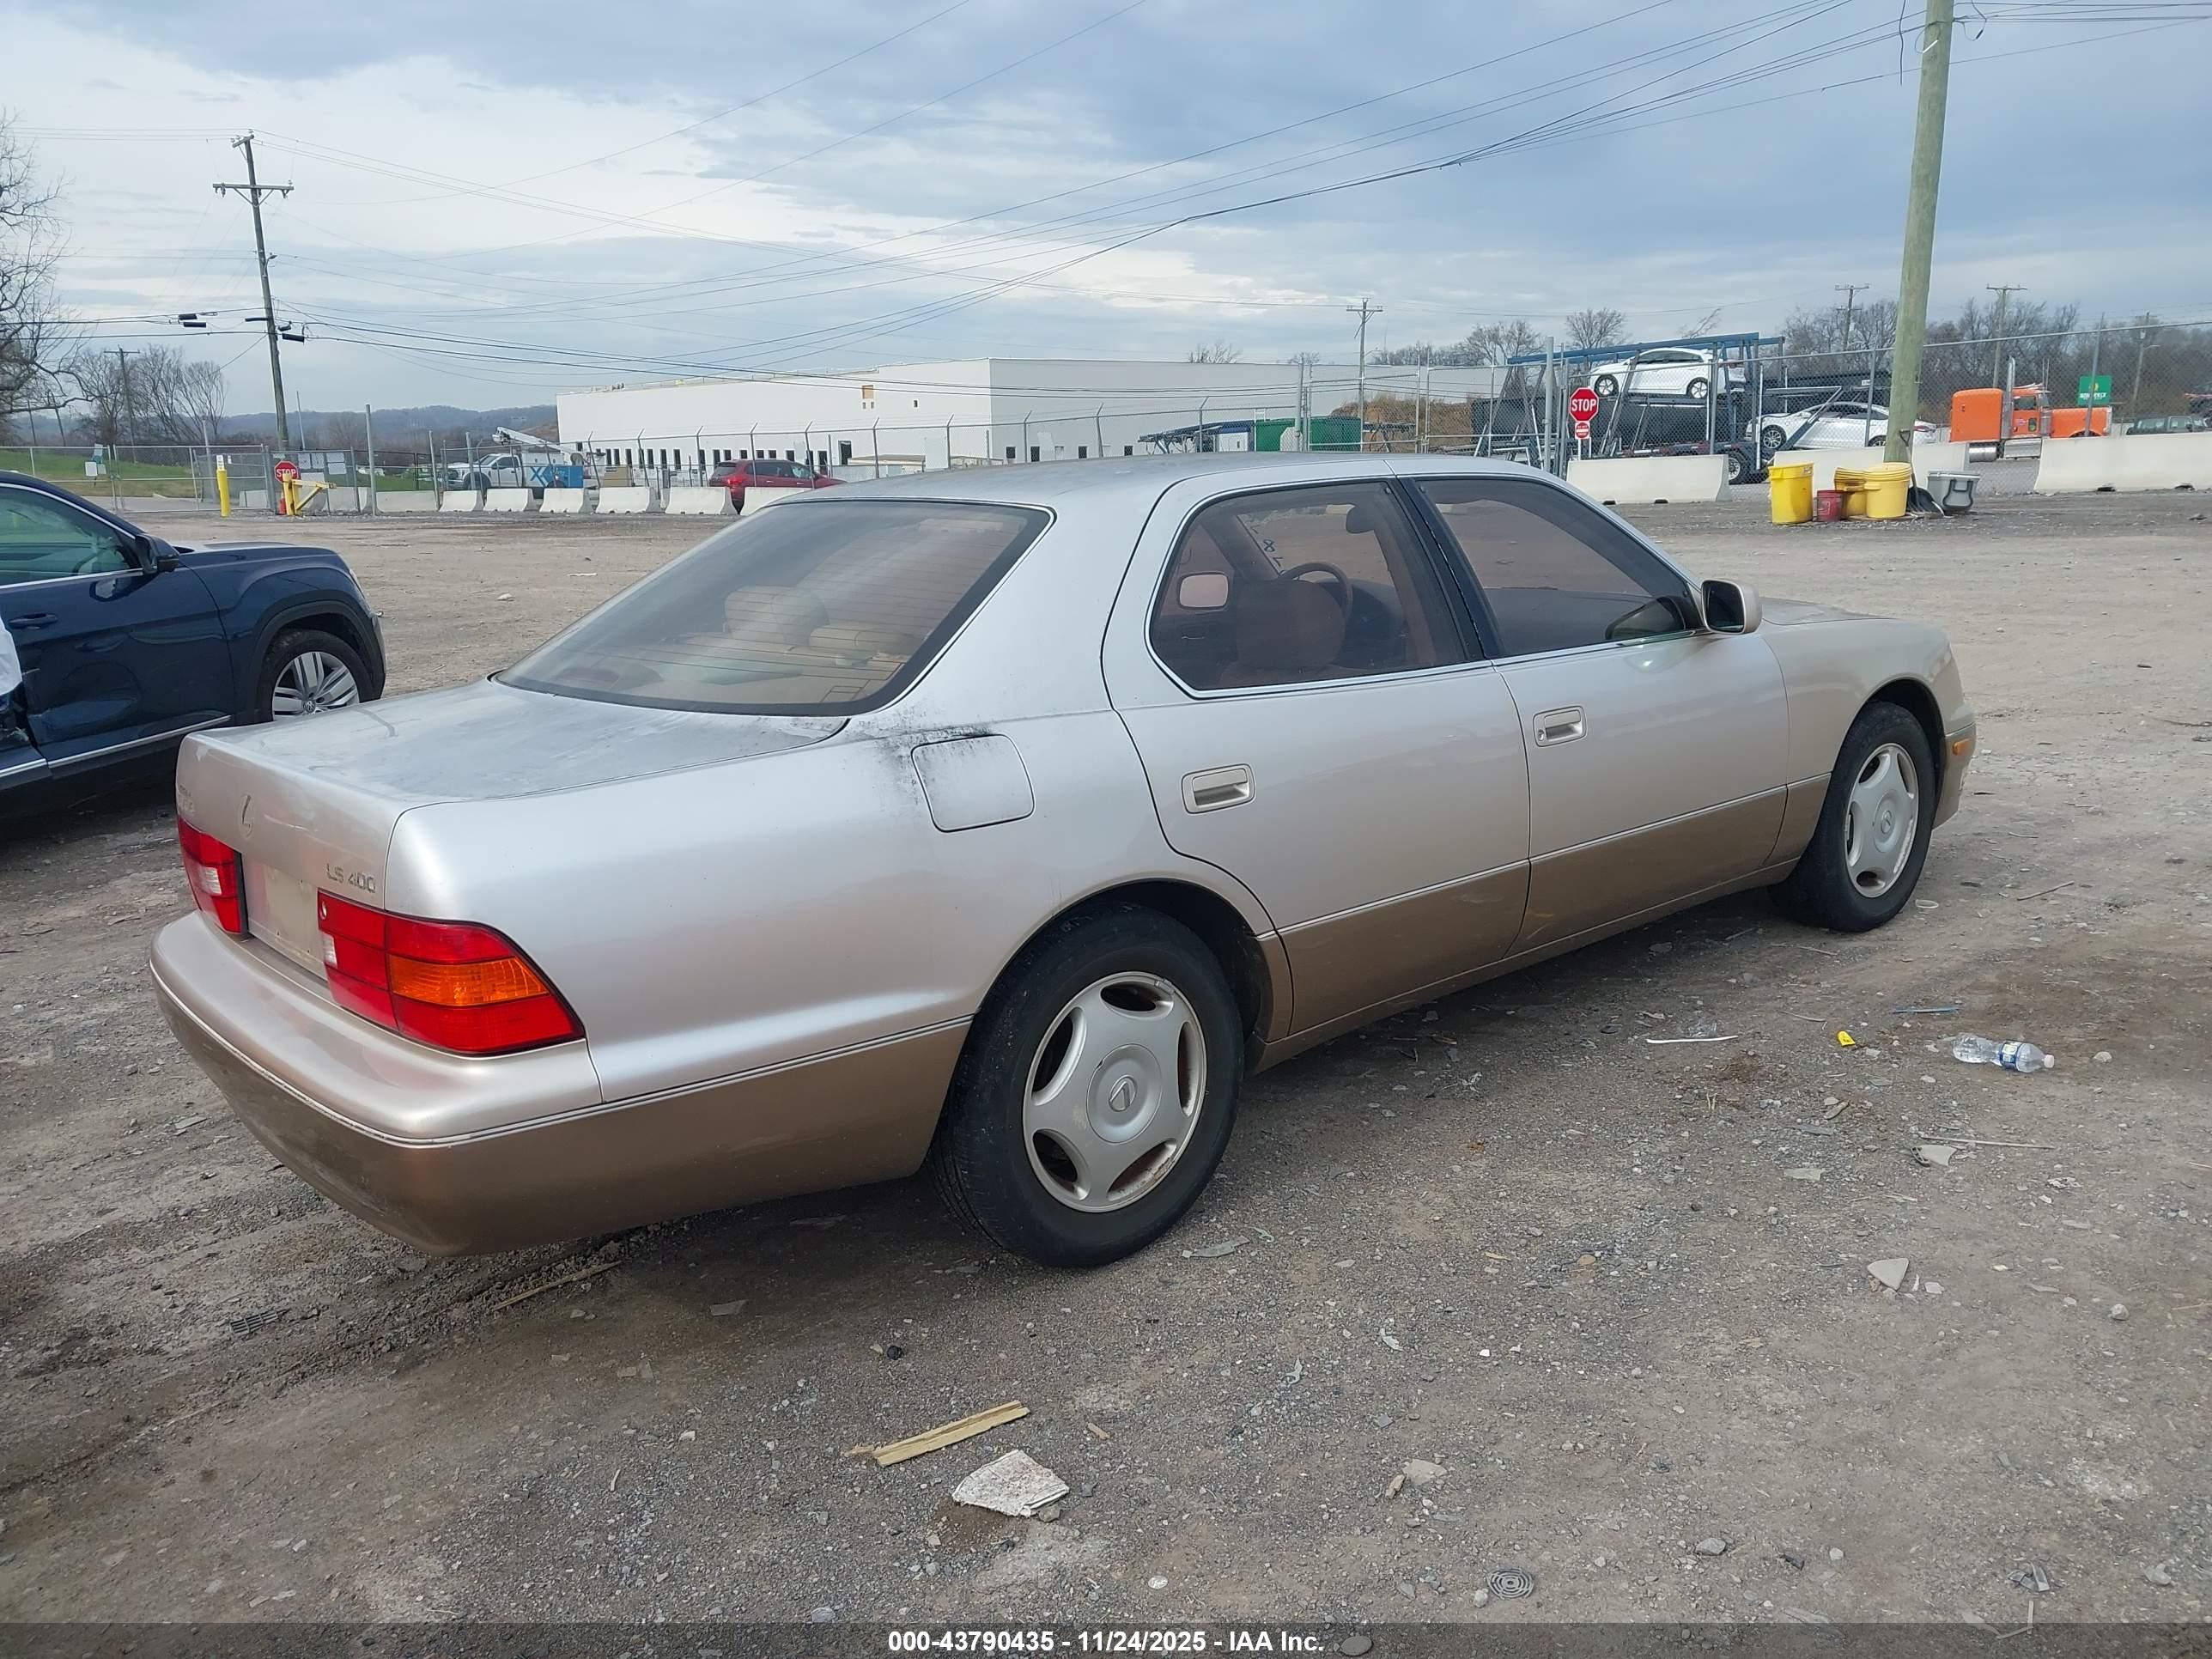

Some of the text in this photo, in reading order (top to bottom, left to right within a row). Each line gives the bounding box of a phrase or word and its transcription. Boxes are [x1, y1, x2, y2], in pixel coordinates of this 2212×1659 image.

[1571, 398, 1597, 412] STOP
[326, 862, 376, 894] LS 400
